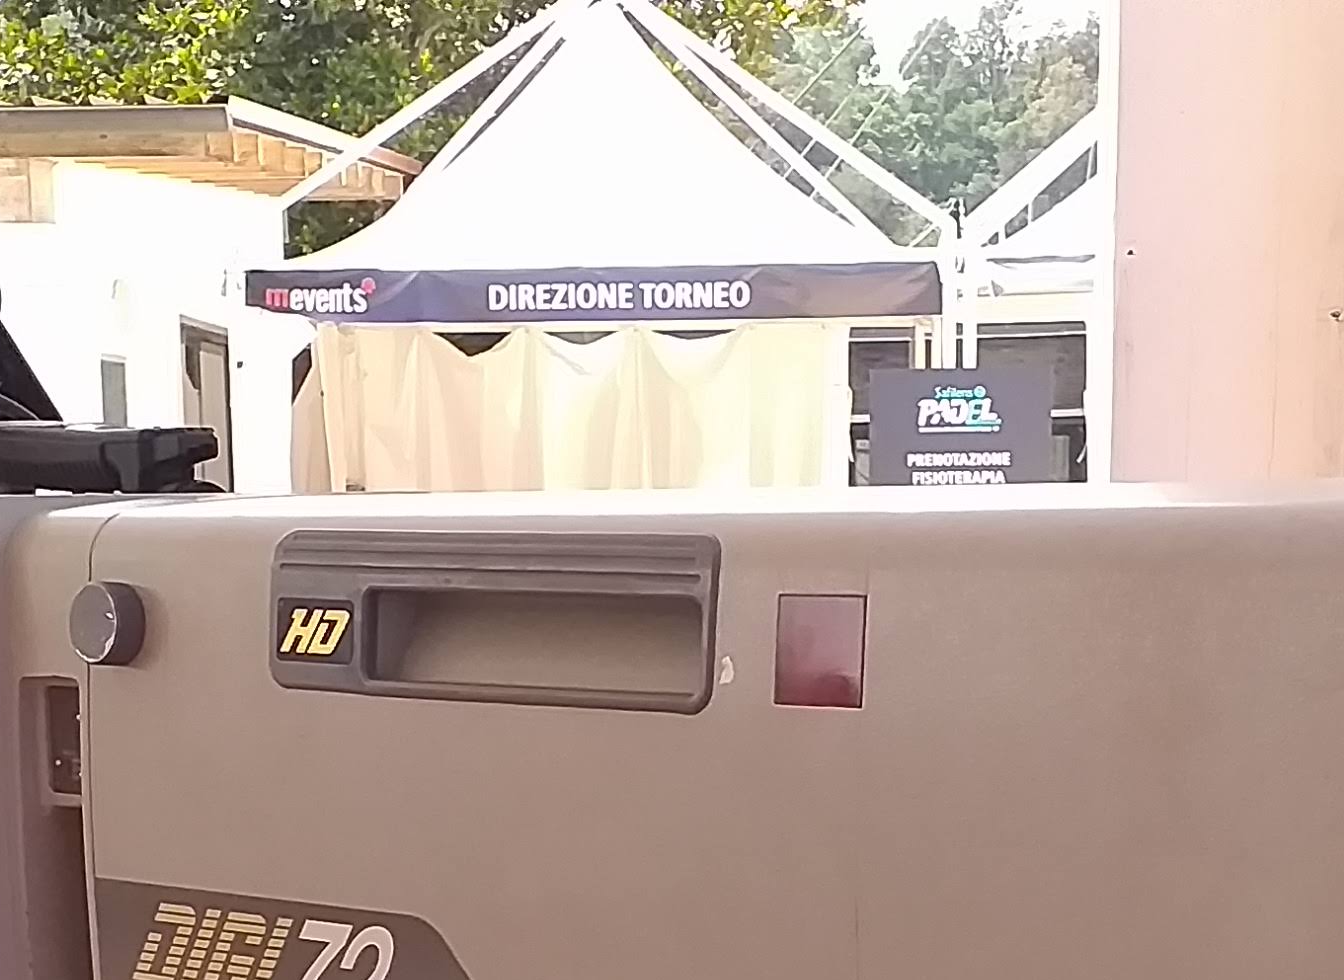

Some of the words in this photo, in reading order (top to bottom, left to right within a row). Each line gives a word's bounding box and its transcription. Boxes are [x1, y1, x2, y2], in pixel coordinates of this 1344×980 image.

[488, 283, 634, 311] DIREZIONE
[639, 280, 752, 310] TORNEO
[917, 397, 1002, 426] PADEL
[907, 452, 1011, 468] PRENOTAZIONE
[912, 470, 1006, 485] FISIOTERAPIA
[279, 608, 351, 656] HD
